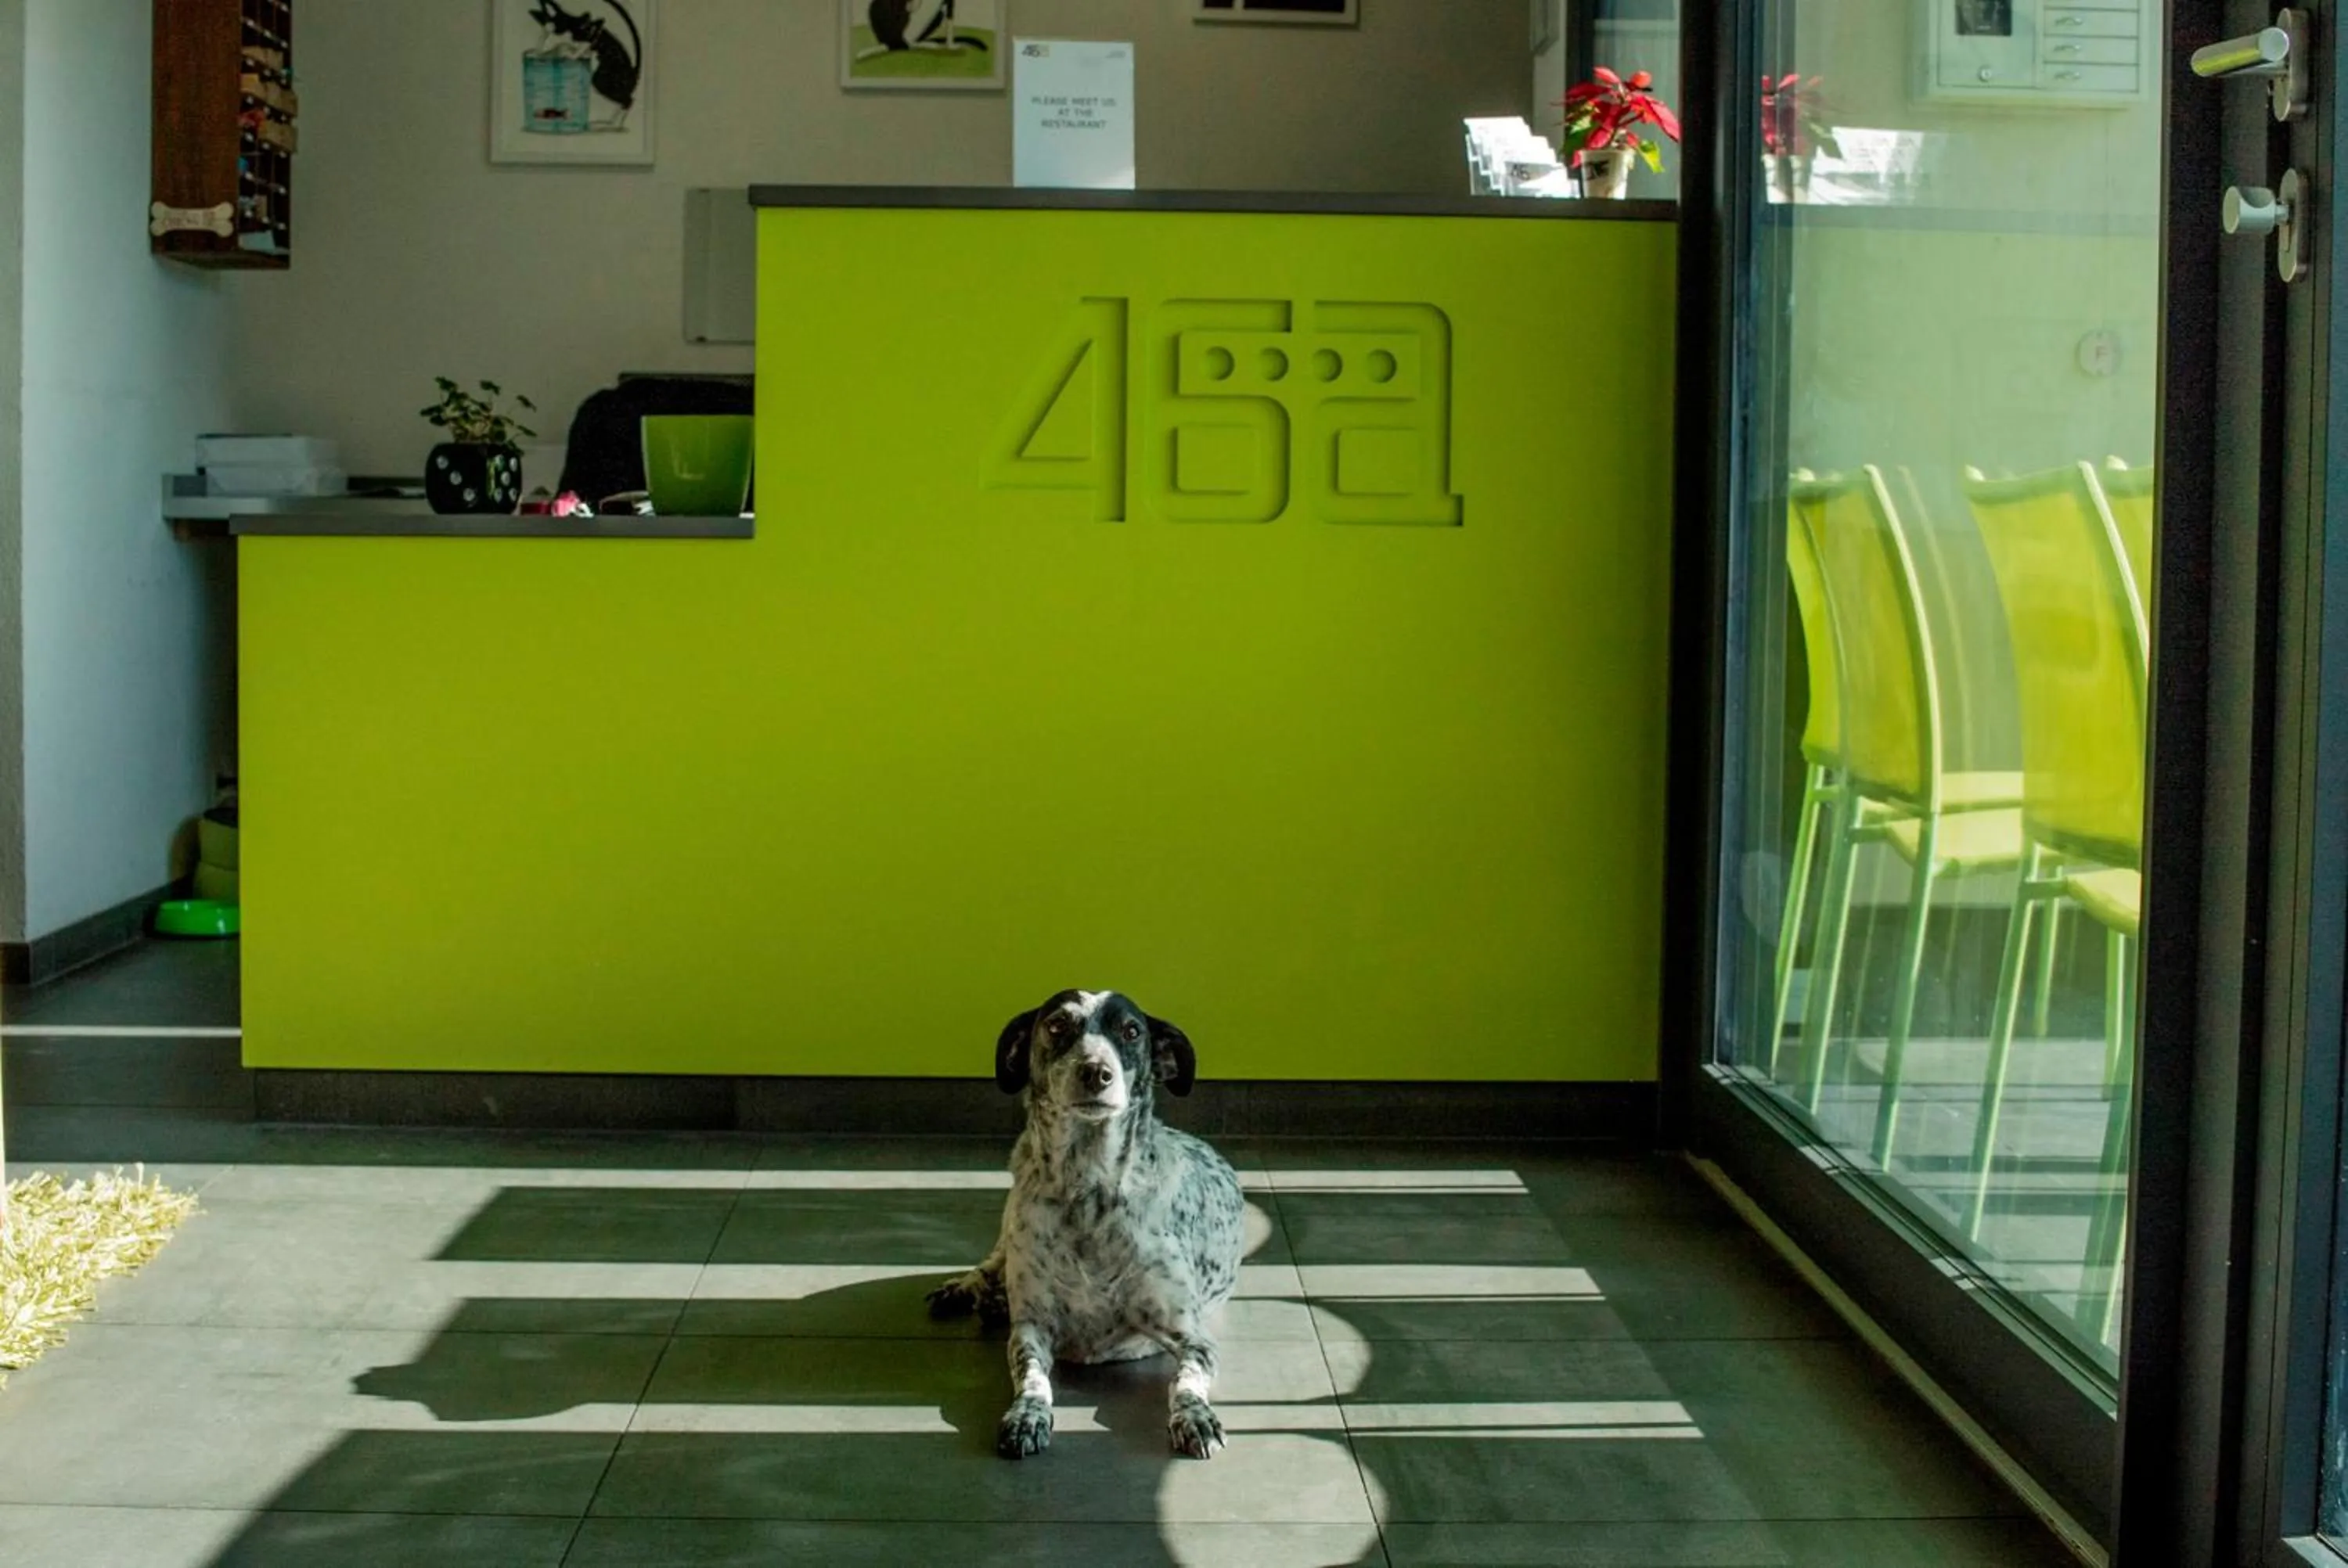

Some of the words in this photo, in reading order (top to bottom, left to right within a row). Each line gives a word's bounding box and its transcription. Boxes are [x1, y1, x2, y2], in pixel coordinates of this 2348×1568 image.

[1031, 97, 1067, 106] PLEASE
[1071, 97, 1098, 106] MEET
[1101, 98, 1116, 107] US
[1074, 108, 1093, 117] THE
[1041, 119, 1107, 129] RESTAURANT
